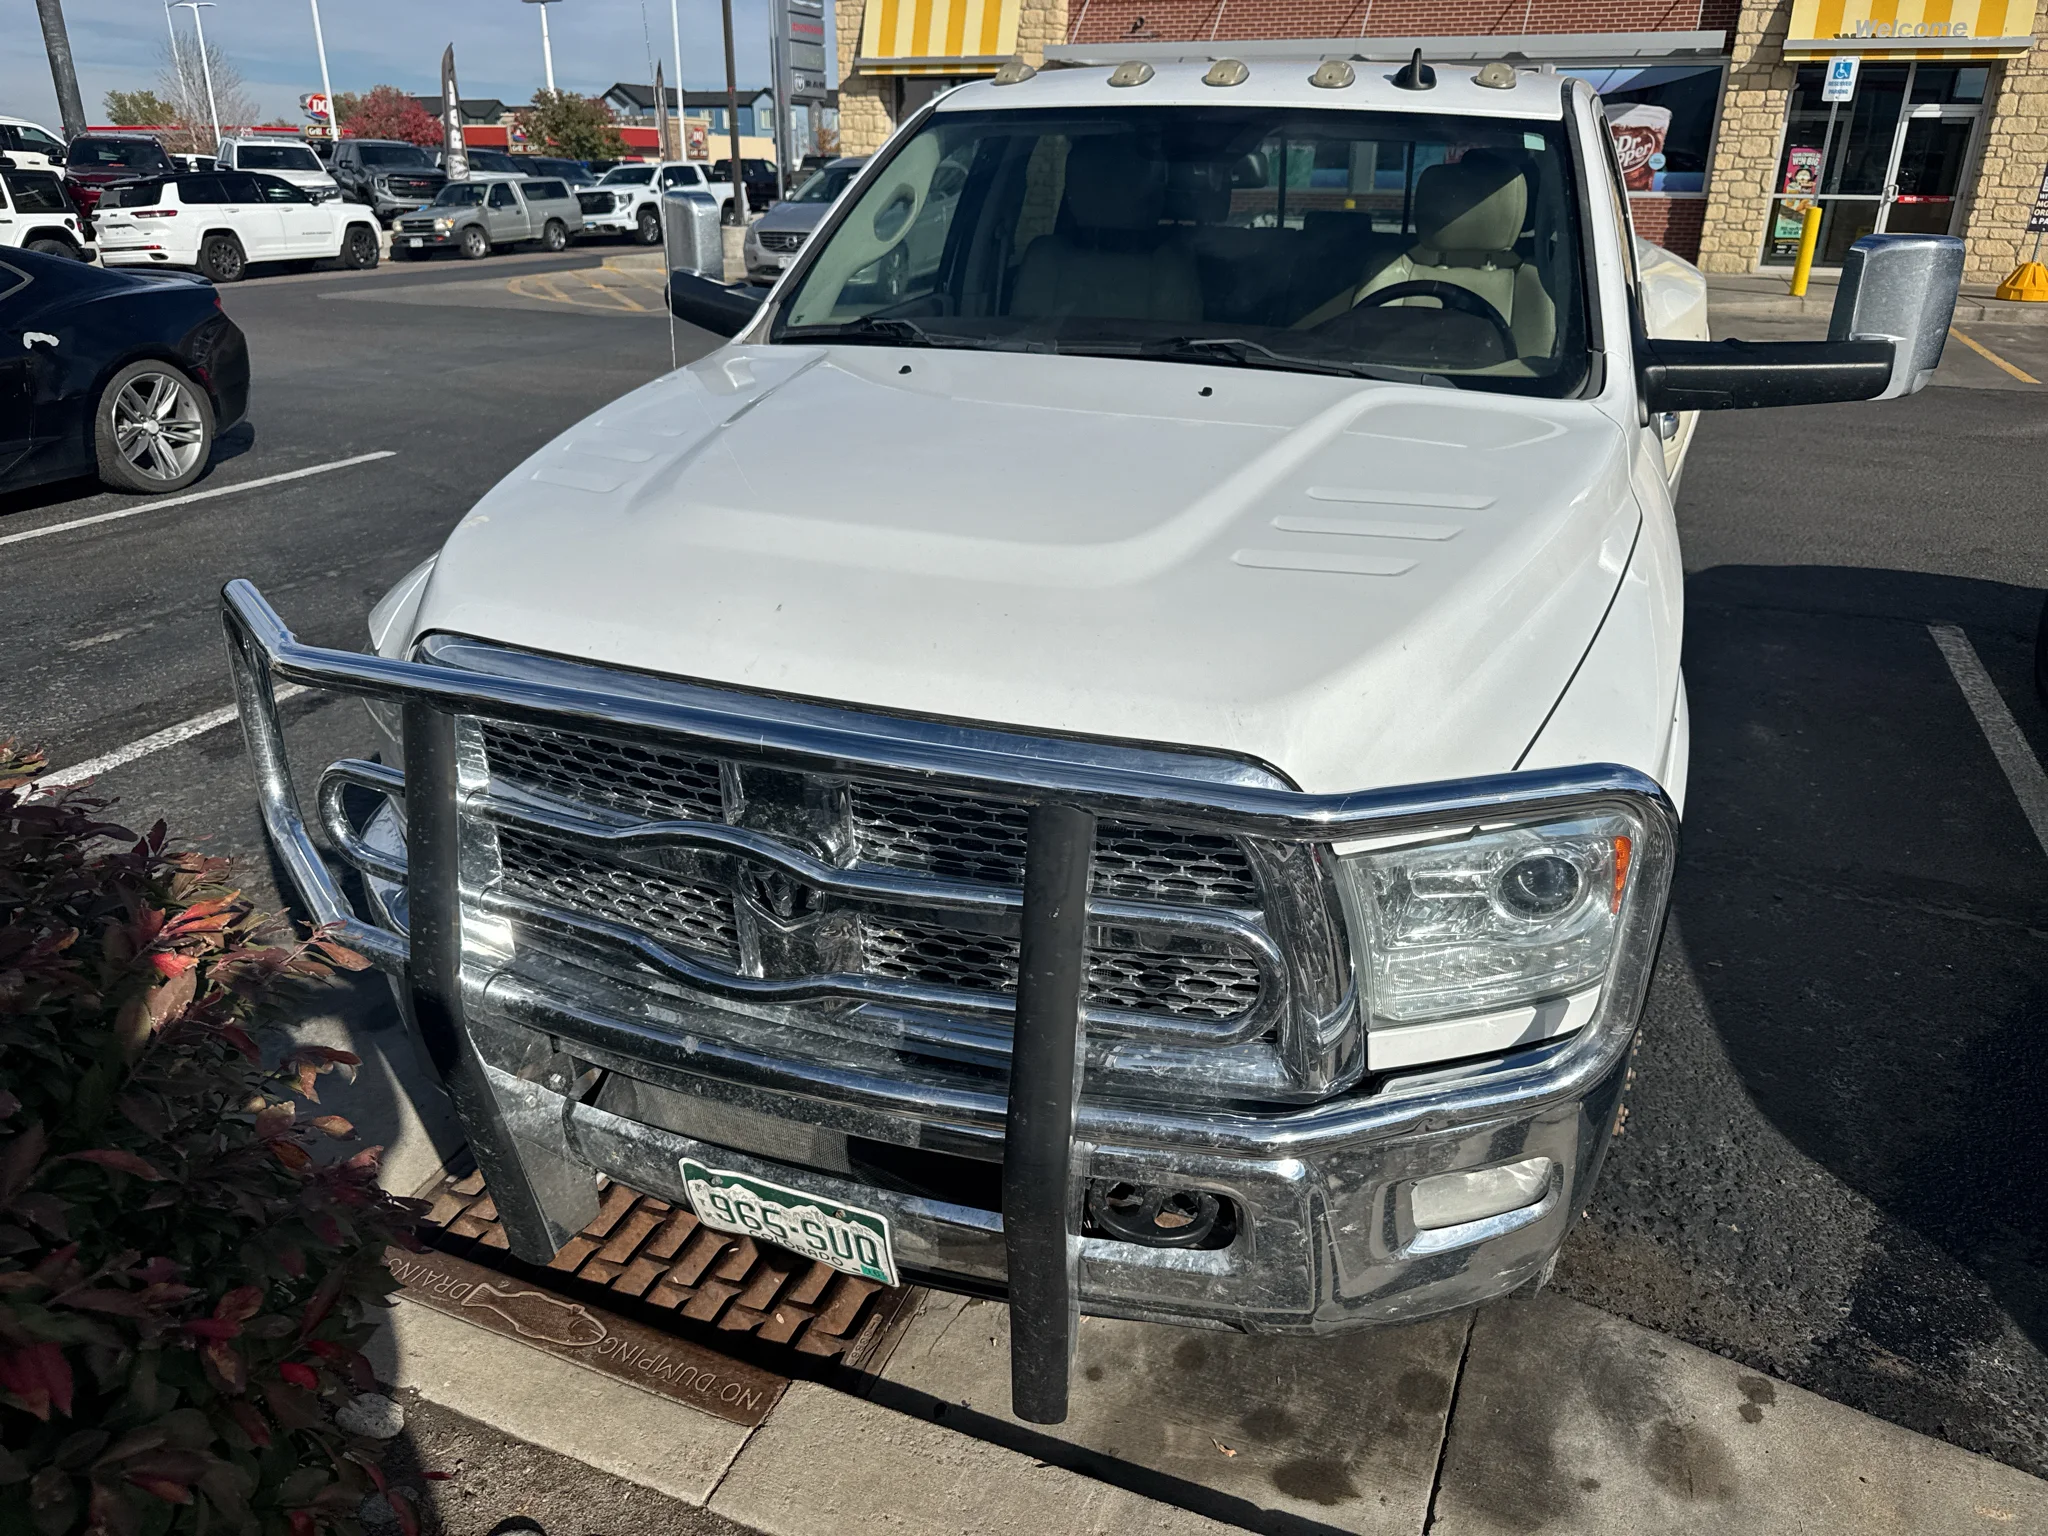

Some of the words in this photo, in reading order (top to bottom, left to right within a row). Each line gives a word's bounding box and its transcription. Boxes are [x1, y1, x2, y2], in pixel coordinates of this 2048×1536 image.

[1856, 19, 1968, 38] Welcome
[805, 80, 825, 89] RAM
[312, 99, 330, 114] DQ
[1618, 135, 1641, 152] Dr
[1618, 143, 1652, 167] pper
[1792, 157, 1806, 166] WIN
[1806, 157, 1820, 166] BIG
[749, 1229, 844, 1267] COLORADO
[388, 1257, 475, 1299] DRAINS
[598, 1336, 717, 1392] DUMPING
[721, 1385, 763, 1411] NO
